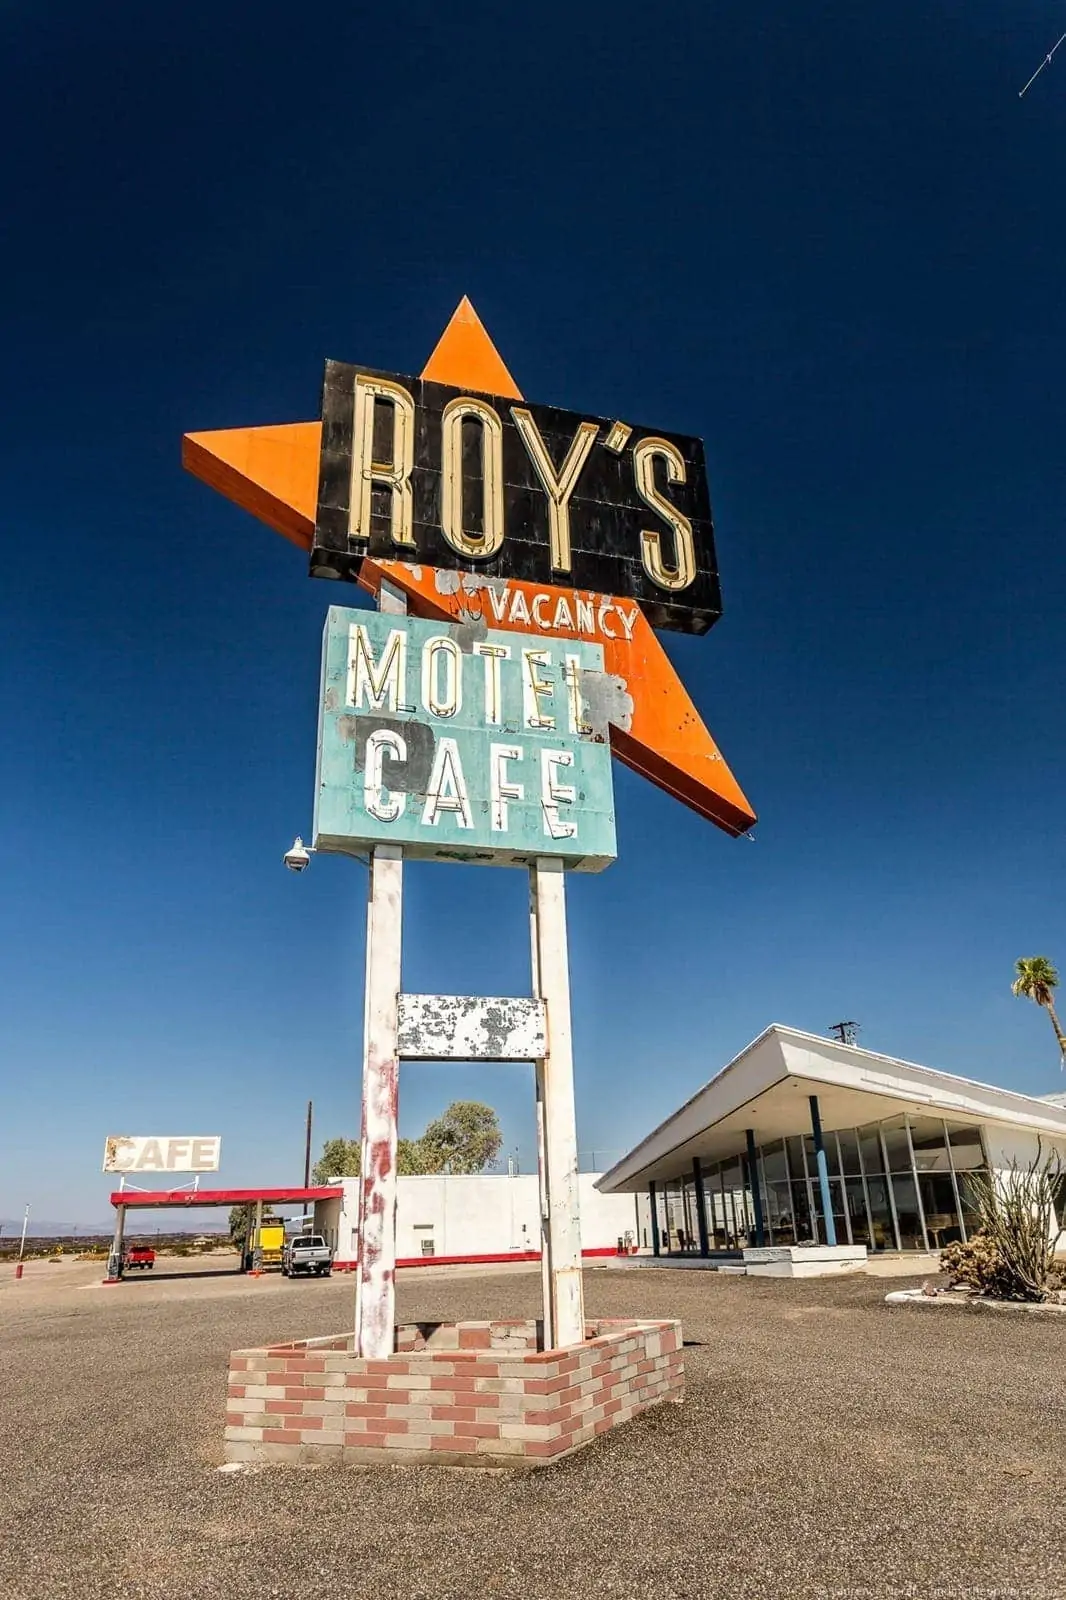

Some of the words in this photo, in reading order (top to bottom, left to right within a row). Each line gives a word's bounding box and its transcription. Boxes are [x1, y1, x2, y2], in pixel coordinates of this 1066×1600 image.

[347, 374, 697, 591] ROY'S
[486, 585, 640, 641] VACANCY
[345, 623, 592, 735] MOTEL
[364, 729, 578, 839] CAFE
[113, 1138, 217, 1169] CAFE
